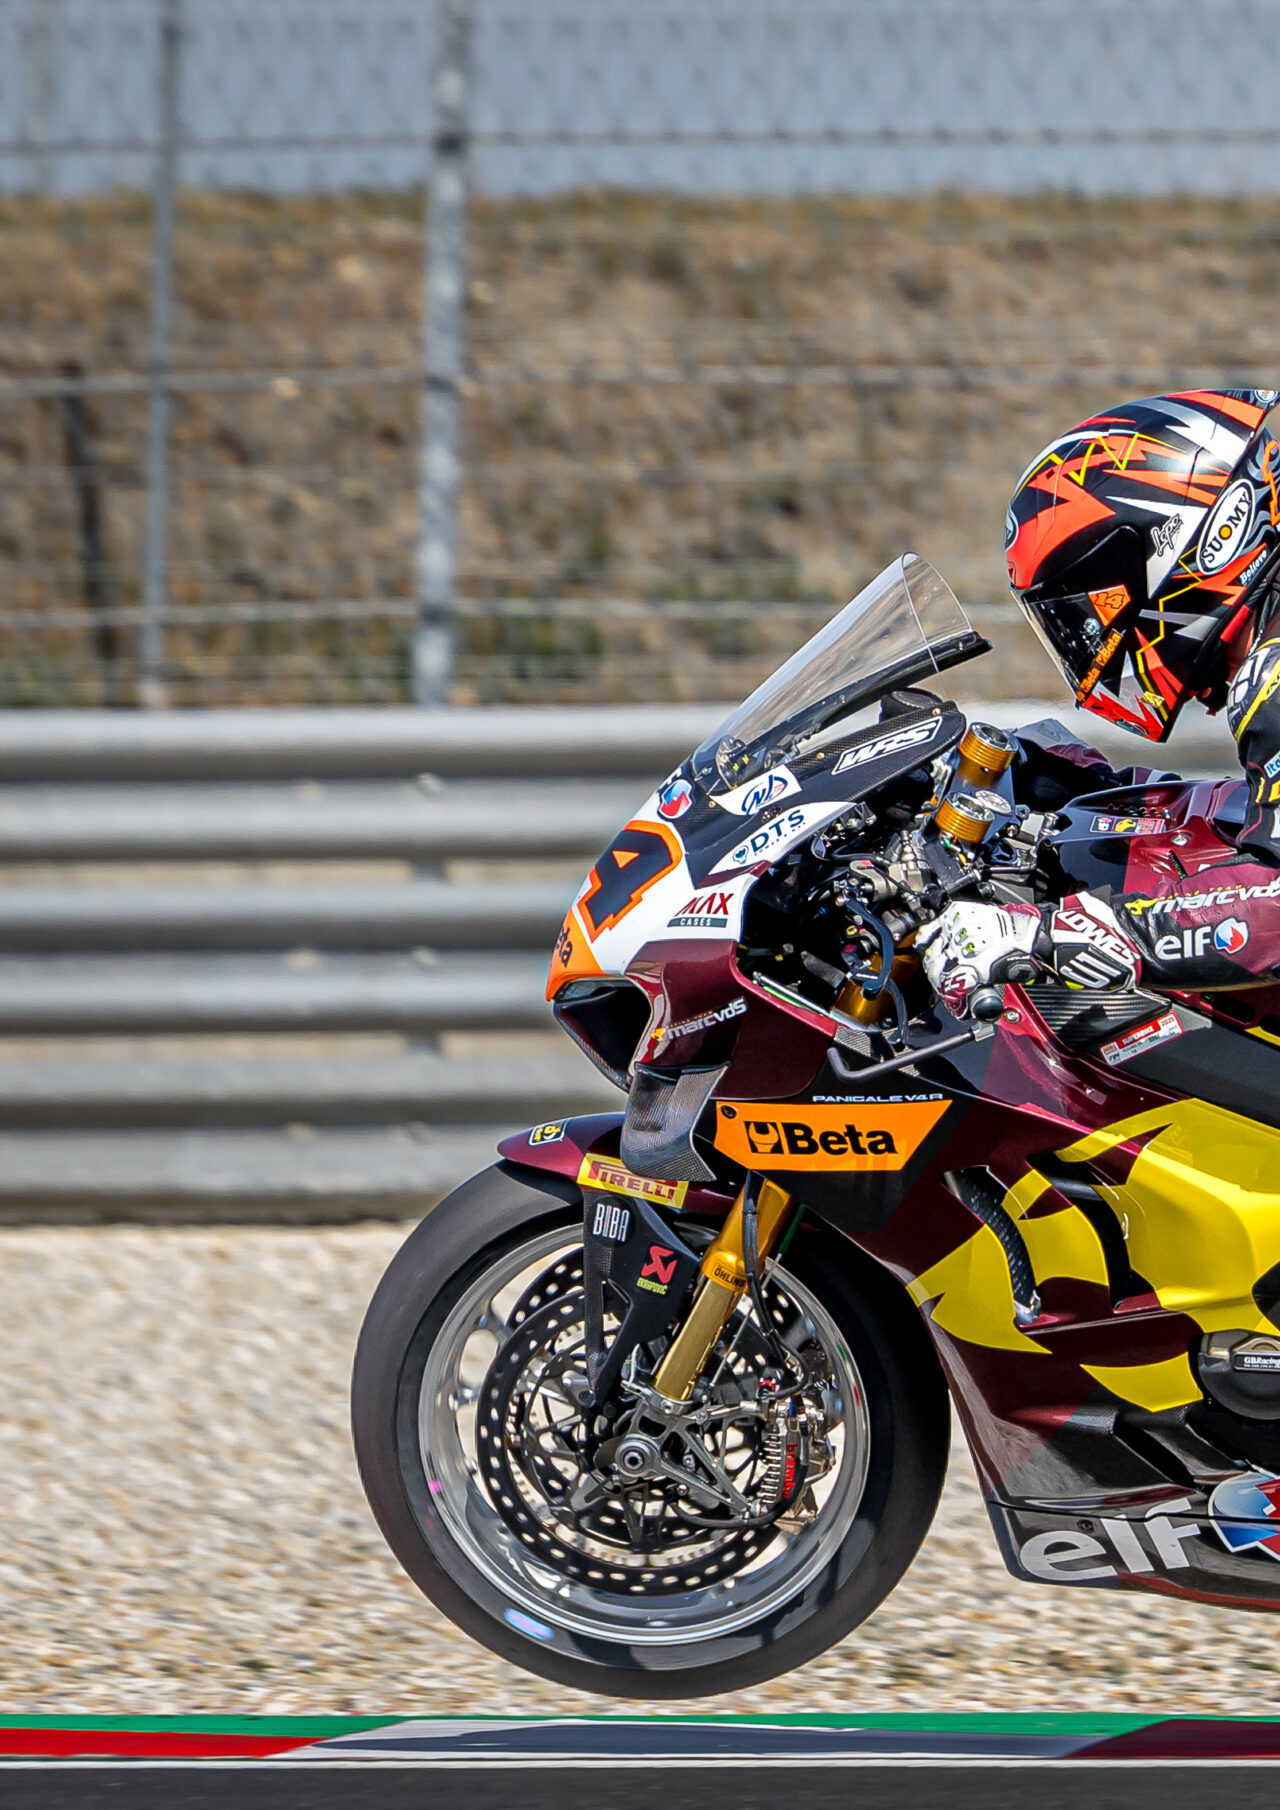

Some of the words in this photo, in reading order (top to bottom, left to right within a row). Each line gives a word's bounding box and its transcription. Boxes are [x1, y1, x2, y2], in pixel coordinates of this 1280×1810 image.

[1202, 492, 1251, 563] SUOMY
[1093, 592, 1124, 609] 14
[838, 722, 936, 770] WRS
[750, 810, 804, 852] DTS
[674, 893, 734, 916] MAX
[680, 918, 712, 926] CASES
[1057, 910, 1140, 966] LOWES
[1155, 925, 1212, 960] elf
[781, 1122, 898, 1155] Beta
[588, 1161, 677, 1200] PIRELLI
[782, 1444, 797, 1499] brembo
[1020, 1497, 1200, 1581] elf
